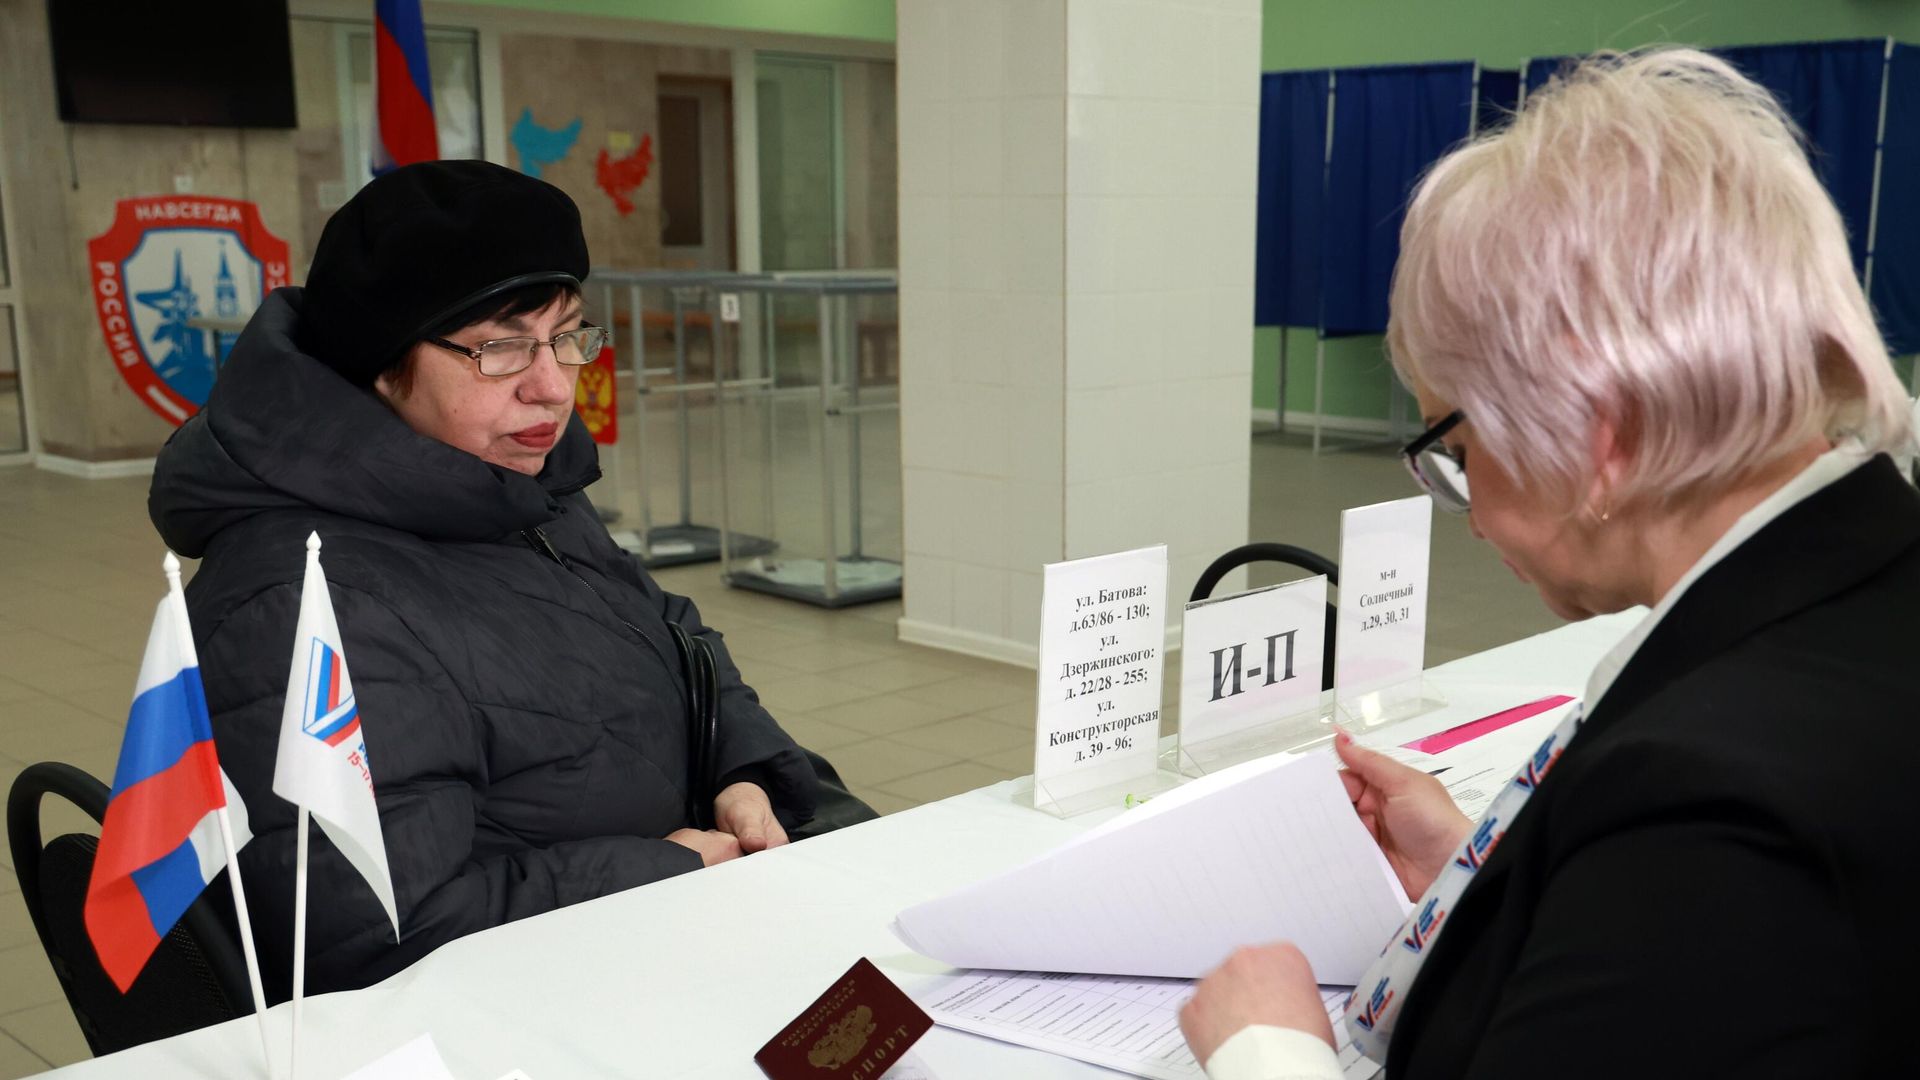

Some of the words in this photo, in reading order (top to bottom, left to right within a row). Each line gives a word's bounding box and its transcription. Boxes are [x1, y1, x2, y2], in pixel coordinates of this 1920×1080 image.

[134, 202, 242, 223] НАВСЕГДА
[98, 261, 140, 368] РОССИЯ
[1380, 569, 1397, 581] м-н
[1075, 596, 1095, 613] ул.
[1098, 585, 1147, 604] Батова:
[1359, 583, 1414, 608] Солнечный
[1069, 609, 1114, 633] д.63/86
[1126, 603, 1150, 621] 130;
[1360, 614, 1383, 633] д.29,
[1384, 610, 1398, 625] 30,
[1399, 607, 1409, 621] 31
[1099, 635, 1119, 651] ул.
[1060, 648, 1155, 681] Дзержинского:
[1208, 629, 1298, 702] И-П
[1065, 688, 1077, 701] д.
[1080, 675, 1112, 696] 22/28
[1123, 668, 1148, 685] 255;
[1096, 700, 1115, 717] ул.
[1049, 710, 1159, 747] Конструкторская
[1074, 751, 1086, 763] д.
[1089, 741, 1103, 758] 39
[1114, 735, 1132, 751] 96;
[852, 1025, 909, 1080] СПОРТ
